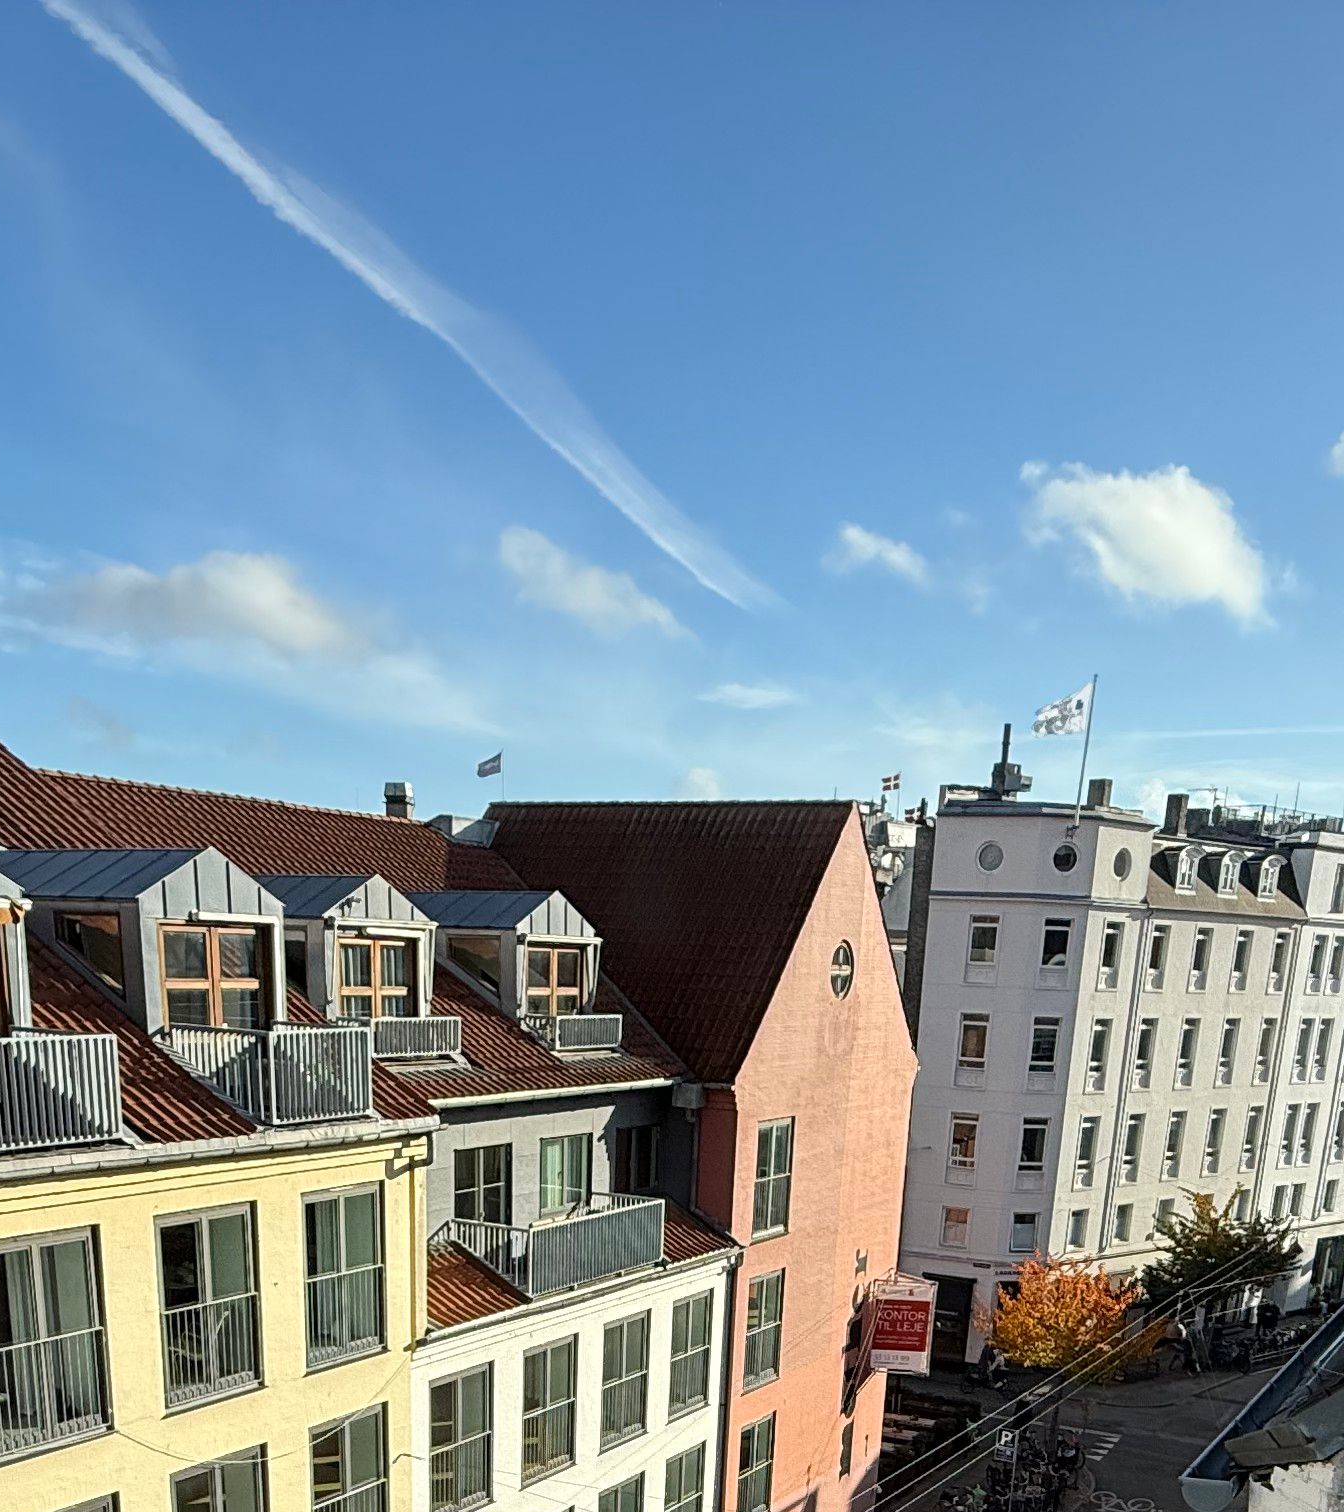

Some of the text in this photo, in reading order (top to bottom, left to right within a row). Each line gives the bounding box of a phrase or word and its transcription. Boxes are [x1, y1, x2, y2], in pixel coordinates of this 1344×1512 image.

[878, 1309, 927, 1321] KONTOR
[878, 1320, 925, 1332] TIL LEJE
[1000, 1430, 1014, 1446] P
